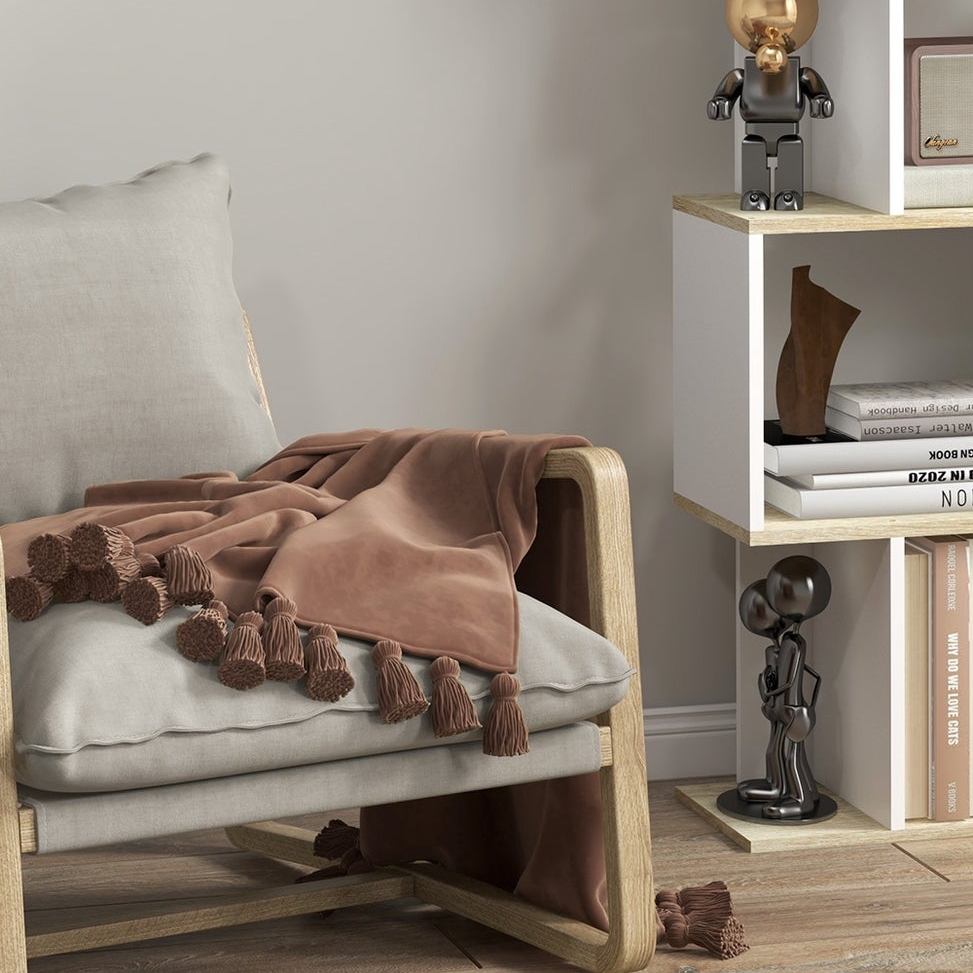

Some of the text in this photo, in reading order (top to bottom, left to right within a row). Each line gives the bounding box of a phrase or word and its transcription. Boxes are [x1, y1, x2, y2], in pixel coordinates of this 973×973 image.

[867, 406, 917, 416] Handbook
[922, 403, 959, 413] Design
[863, 424, 921, 435] Isaacson
[930, 421, 972, 433] Walter
[928, 449, 958, 460] BOOK
[908, 472, 947, 483] 2020
[951, 470, 965, 481] IN
[947, 633, 959, 746] WHY DO WE LOVE CATS
